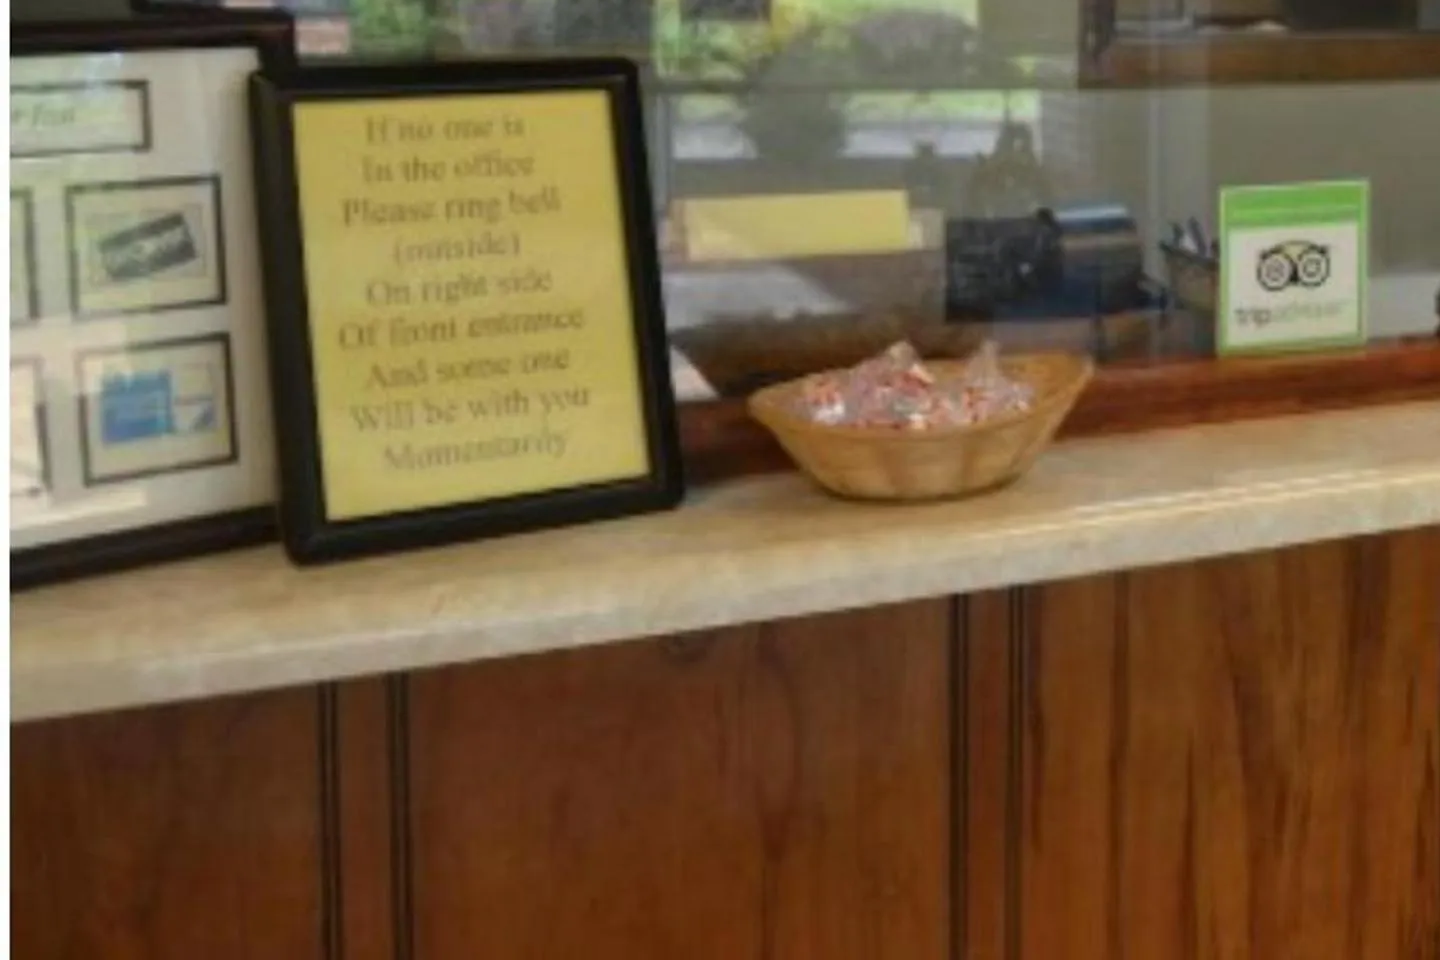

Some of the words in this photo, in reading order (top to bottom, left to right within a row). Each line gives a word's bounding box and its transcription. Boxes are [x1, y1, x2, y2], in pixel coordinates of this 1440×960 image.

[364, 115, 393, 144] If
[401, 119, 434, 142] no
[443, 117, 495, 141] one
[503, 114, 526, 138] is
[361, 154, 394, 184] In
[401, 154, 446, 183] the
[453, 152, 536, 181] office
[342, 196, 437, 228] Please
[444, 195, 500, 226] ring
[508, 186, 563, 215] bell
[392, 230, 523, 267] (outside)
[365, 278, 412, 308] On
[420, 271, 489, 307] right
[497, 267, 554, 296] side
[338, 319, 383, 352] Of
[387, 315, 459, 347] front
[466, 306, 588, 340] entrance
[364, 357, 430, 390] And
[435, 353, 513, 382] some
[519, 347, 571, 375] one
[350, 401, 416, 434] Will
[421, 396, 457, 427] be
[466, 389, 531, 421] with
[539, 385, 592, 420] you
